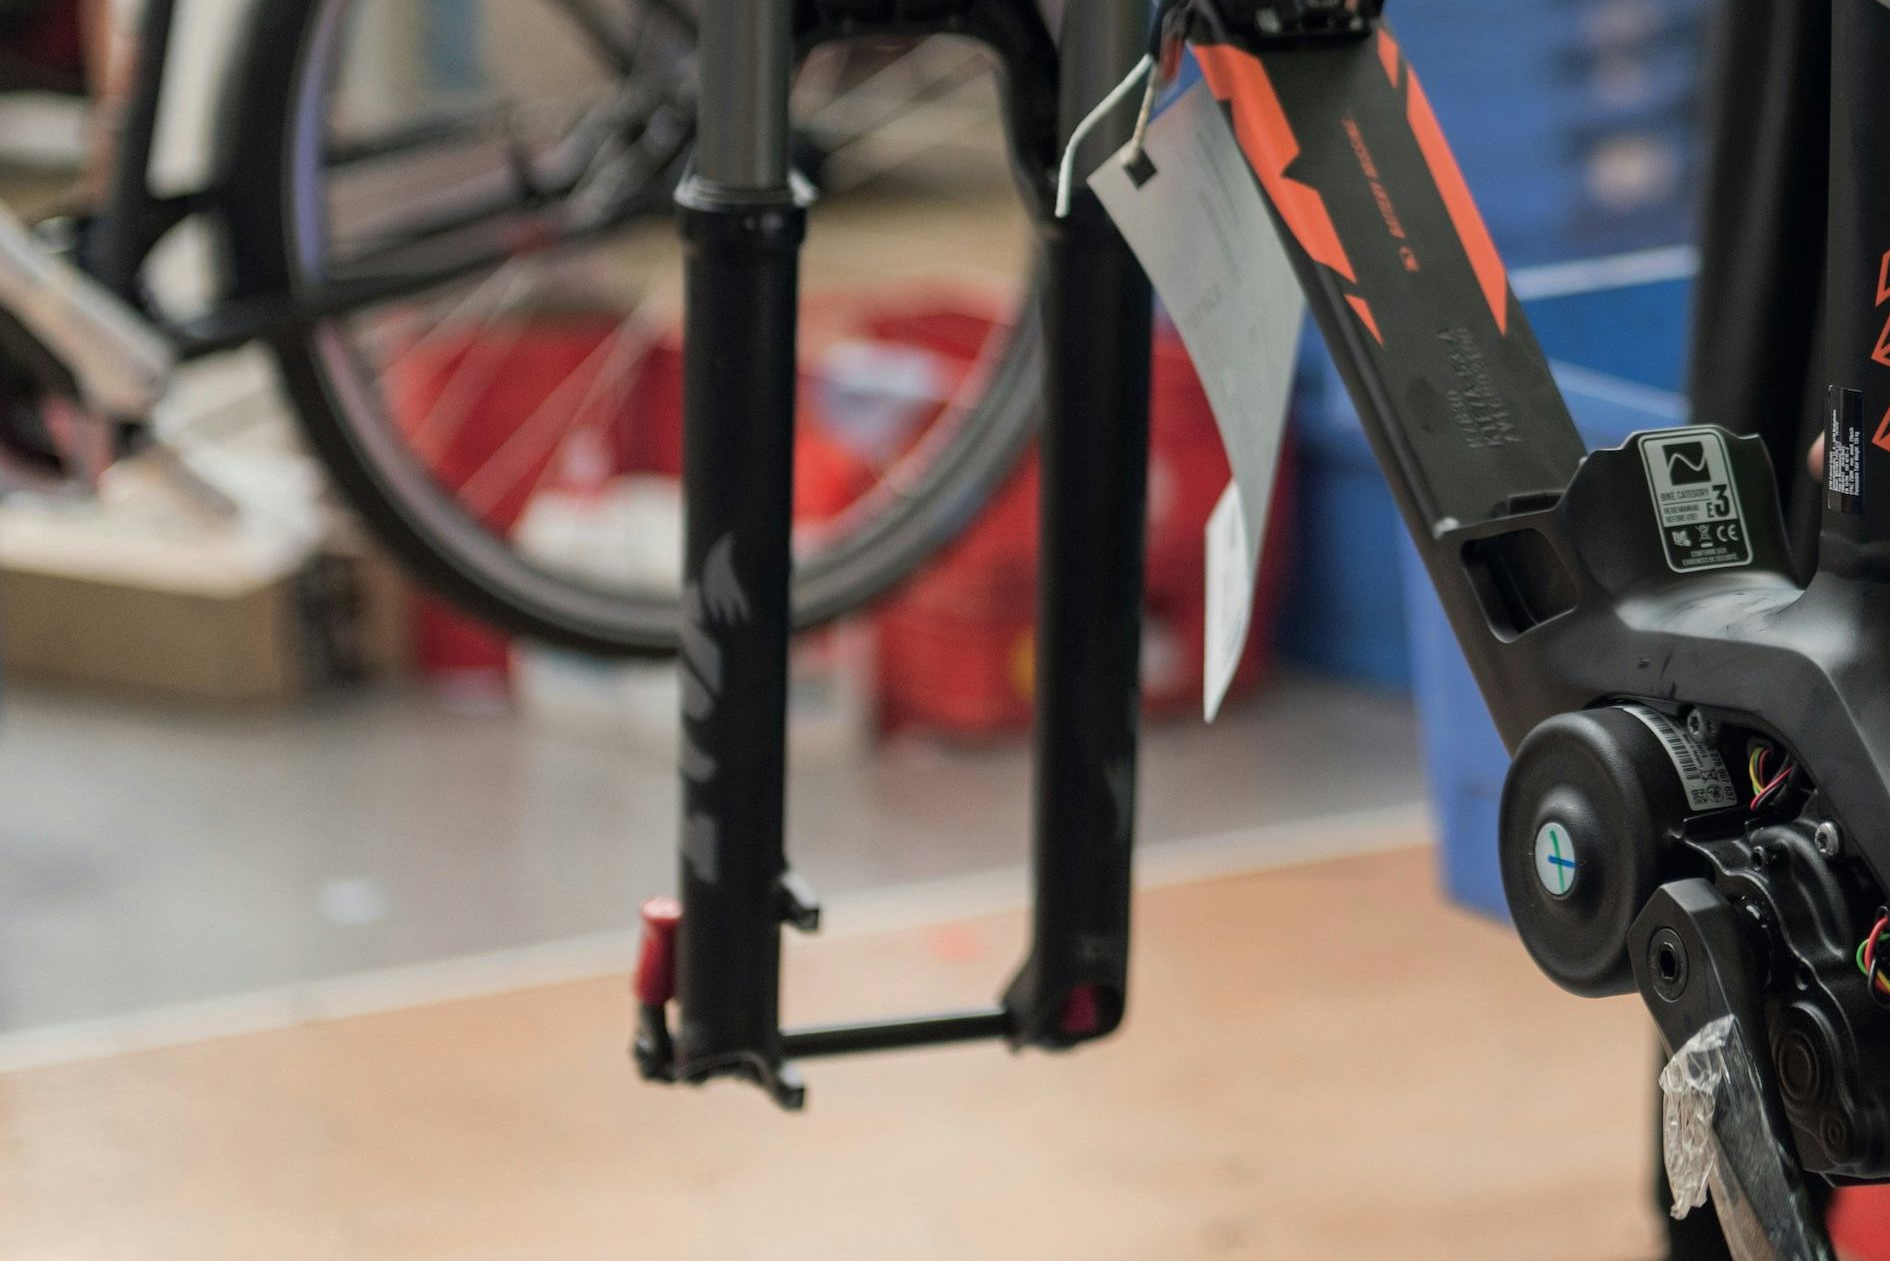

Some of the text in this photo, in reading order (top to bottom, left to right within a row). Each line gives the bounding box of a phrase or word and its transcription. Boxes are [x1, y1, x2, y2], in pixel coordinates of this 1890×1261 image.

[1660, 489, 1708, 501] BIKE CATEGORY
[1716, 524, 1739, 542] CE
